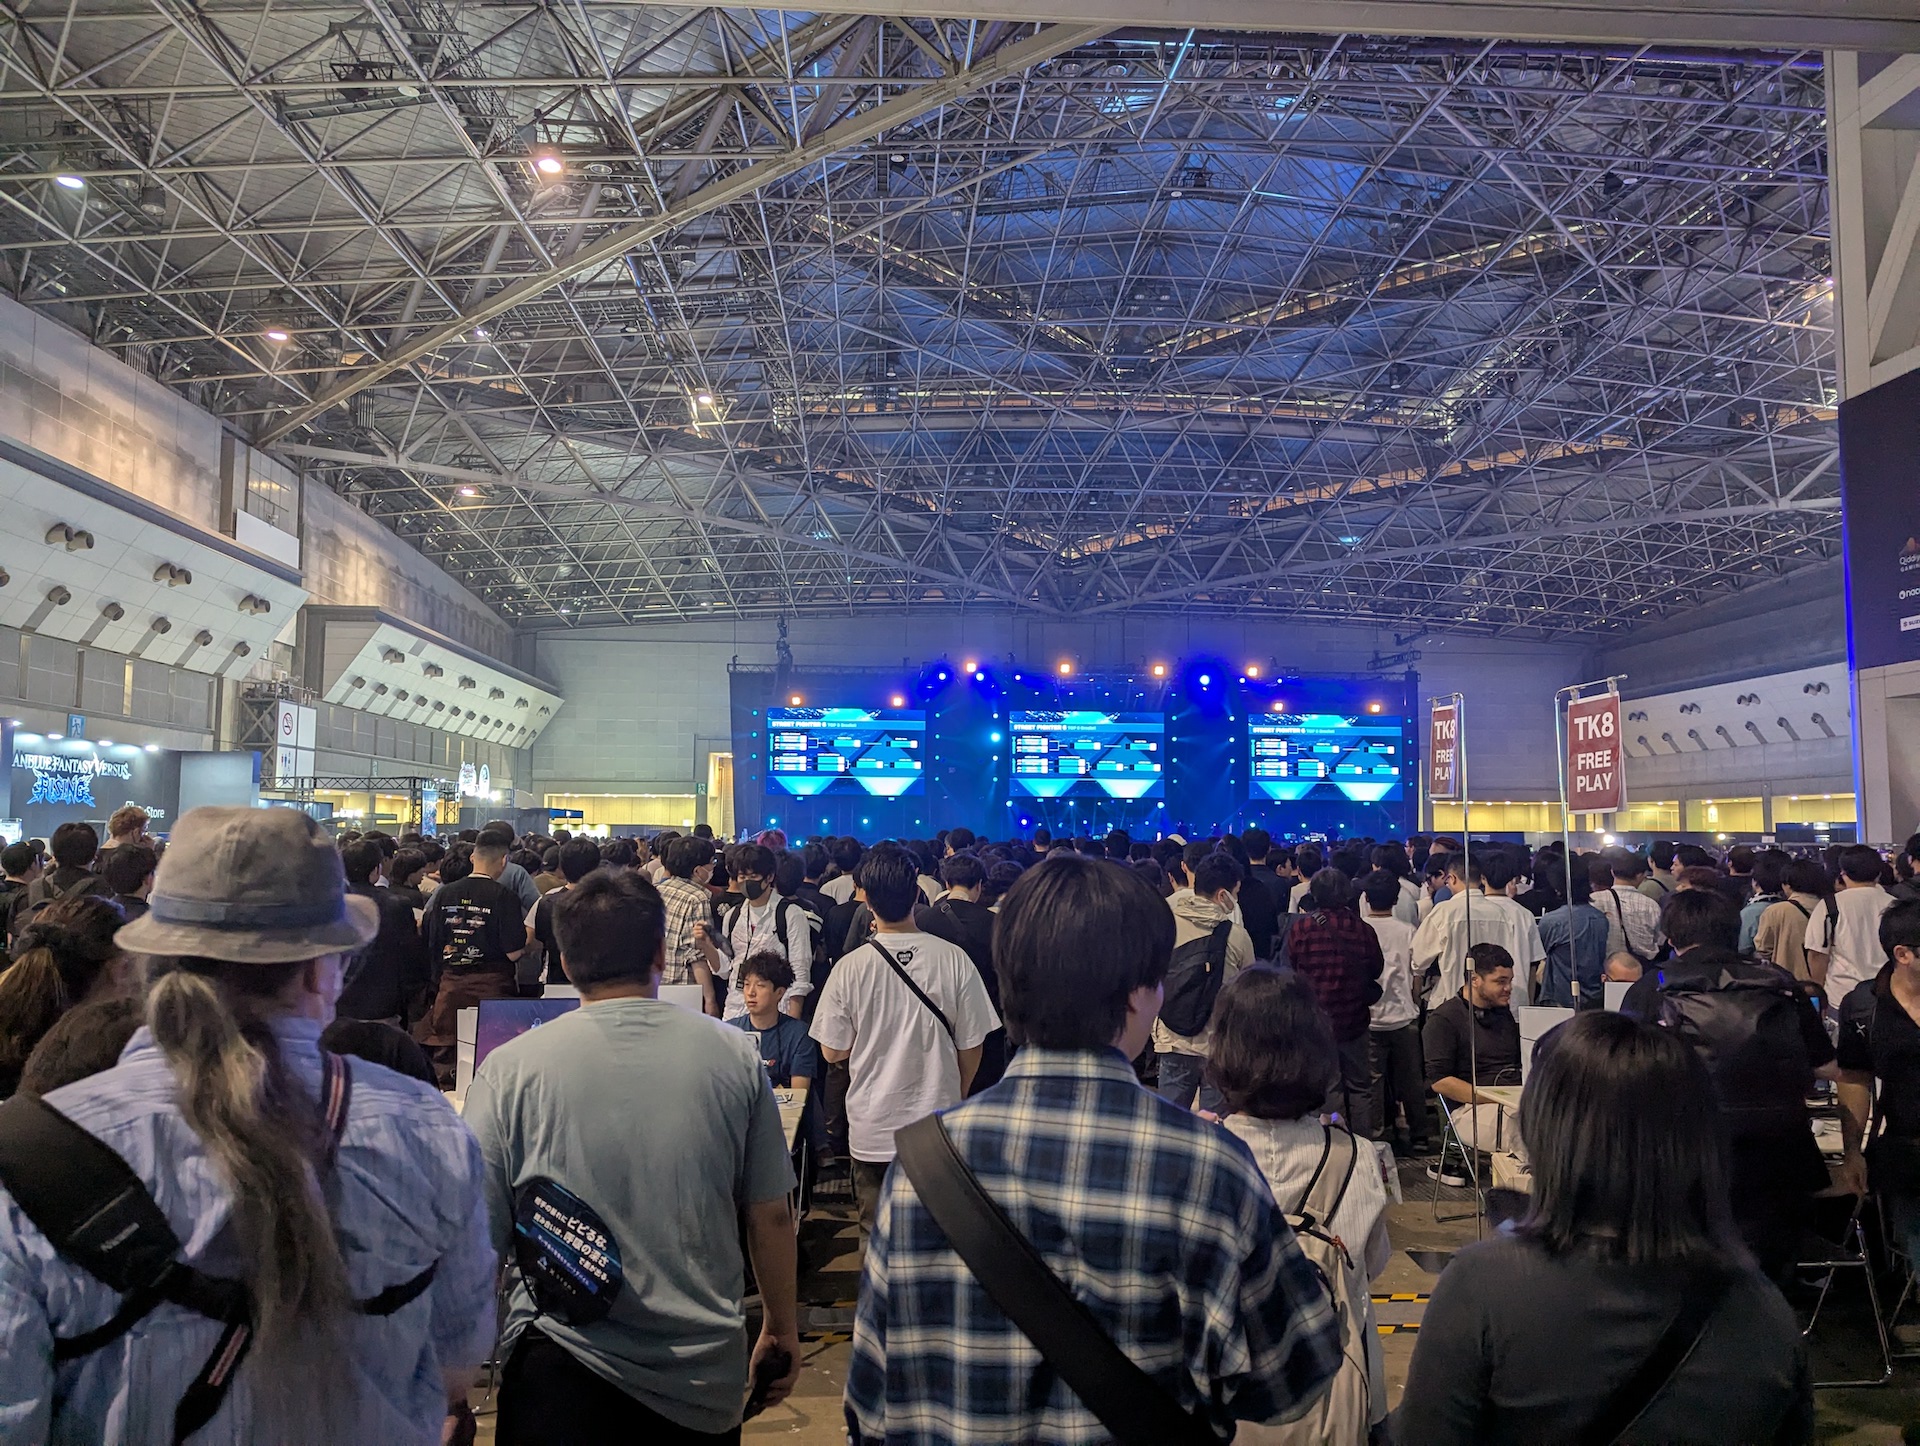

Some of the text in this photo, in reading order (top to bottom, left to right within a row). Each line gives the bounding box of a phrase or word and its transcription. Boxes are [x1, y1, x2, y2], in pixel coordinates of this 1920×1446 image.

[1434, 718, 1456, 740] TK8
[1574, 711, 1615, 741] TK8
[51, 755, 95, 775] FANTASY
[93, 752, 131, 780] VERSUS
[1435, 749, 1454, 764] FREE
[1577, 749, 1612, 770] FREE
[30, 771, 94, 806] RISING
[1576, 772, 1613, 793] PLAY
